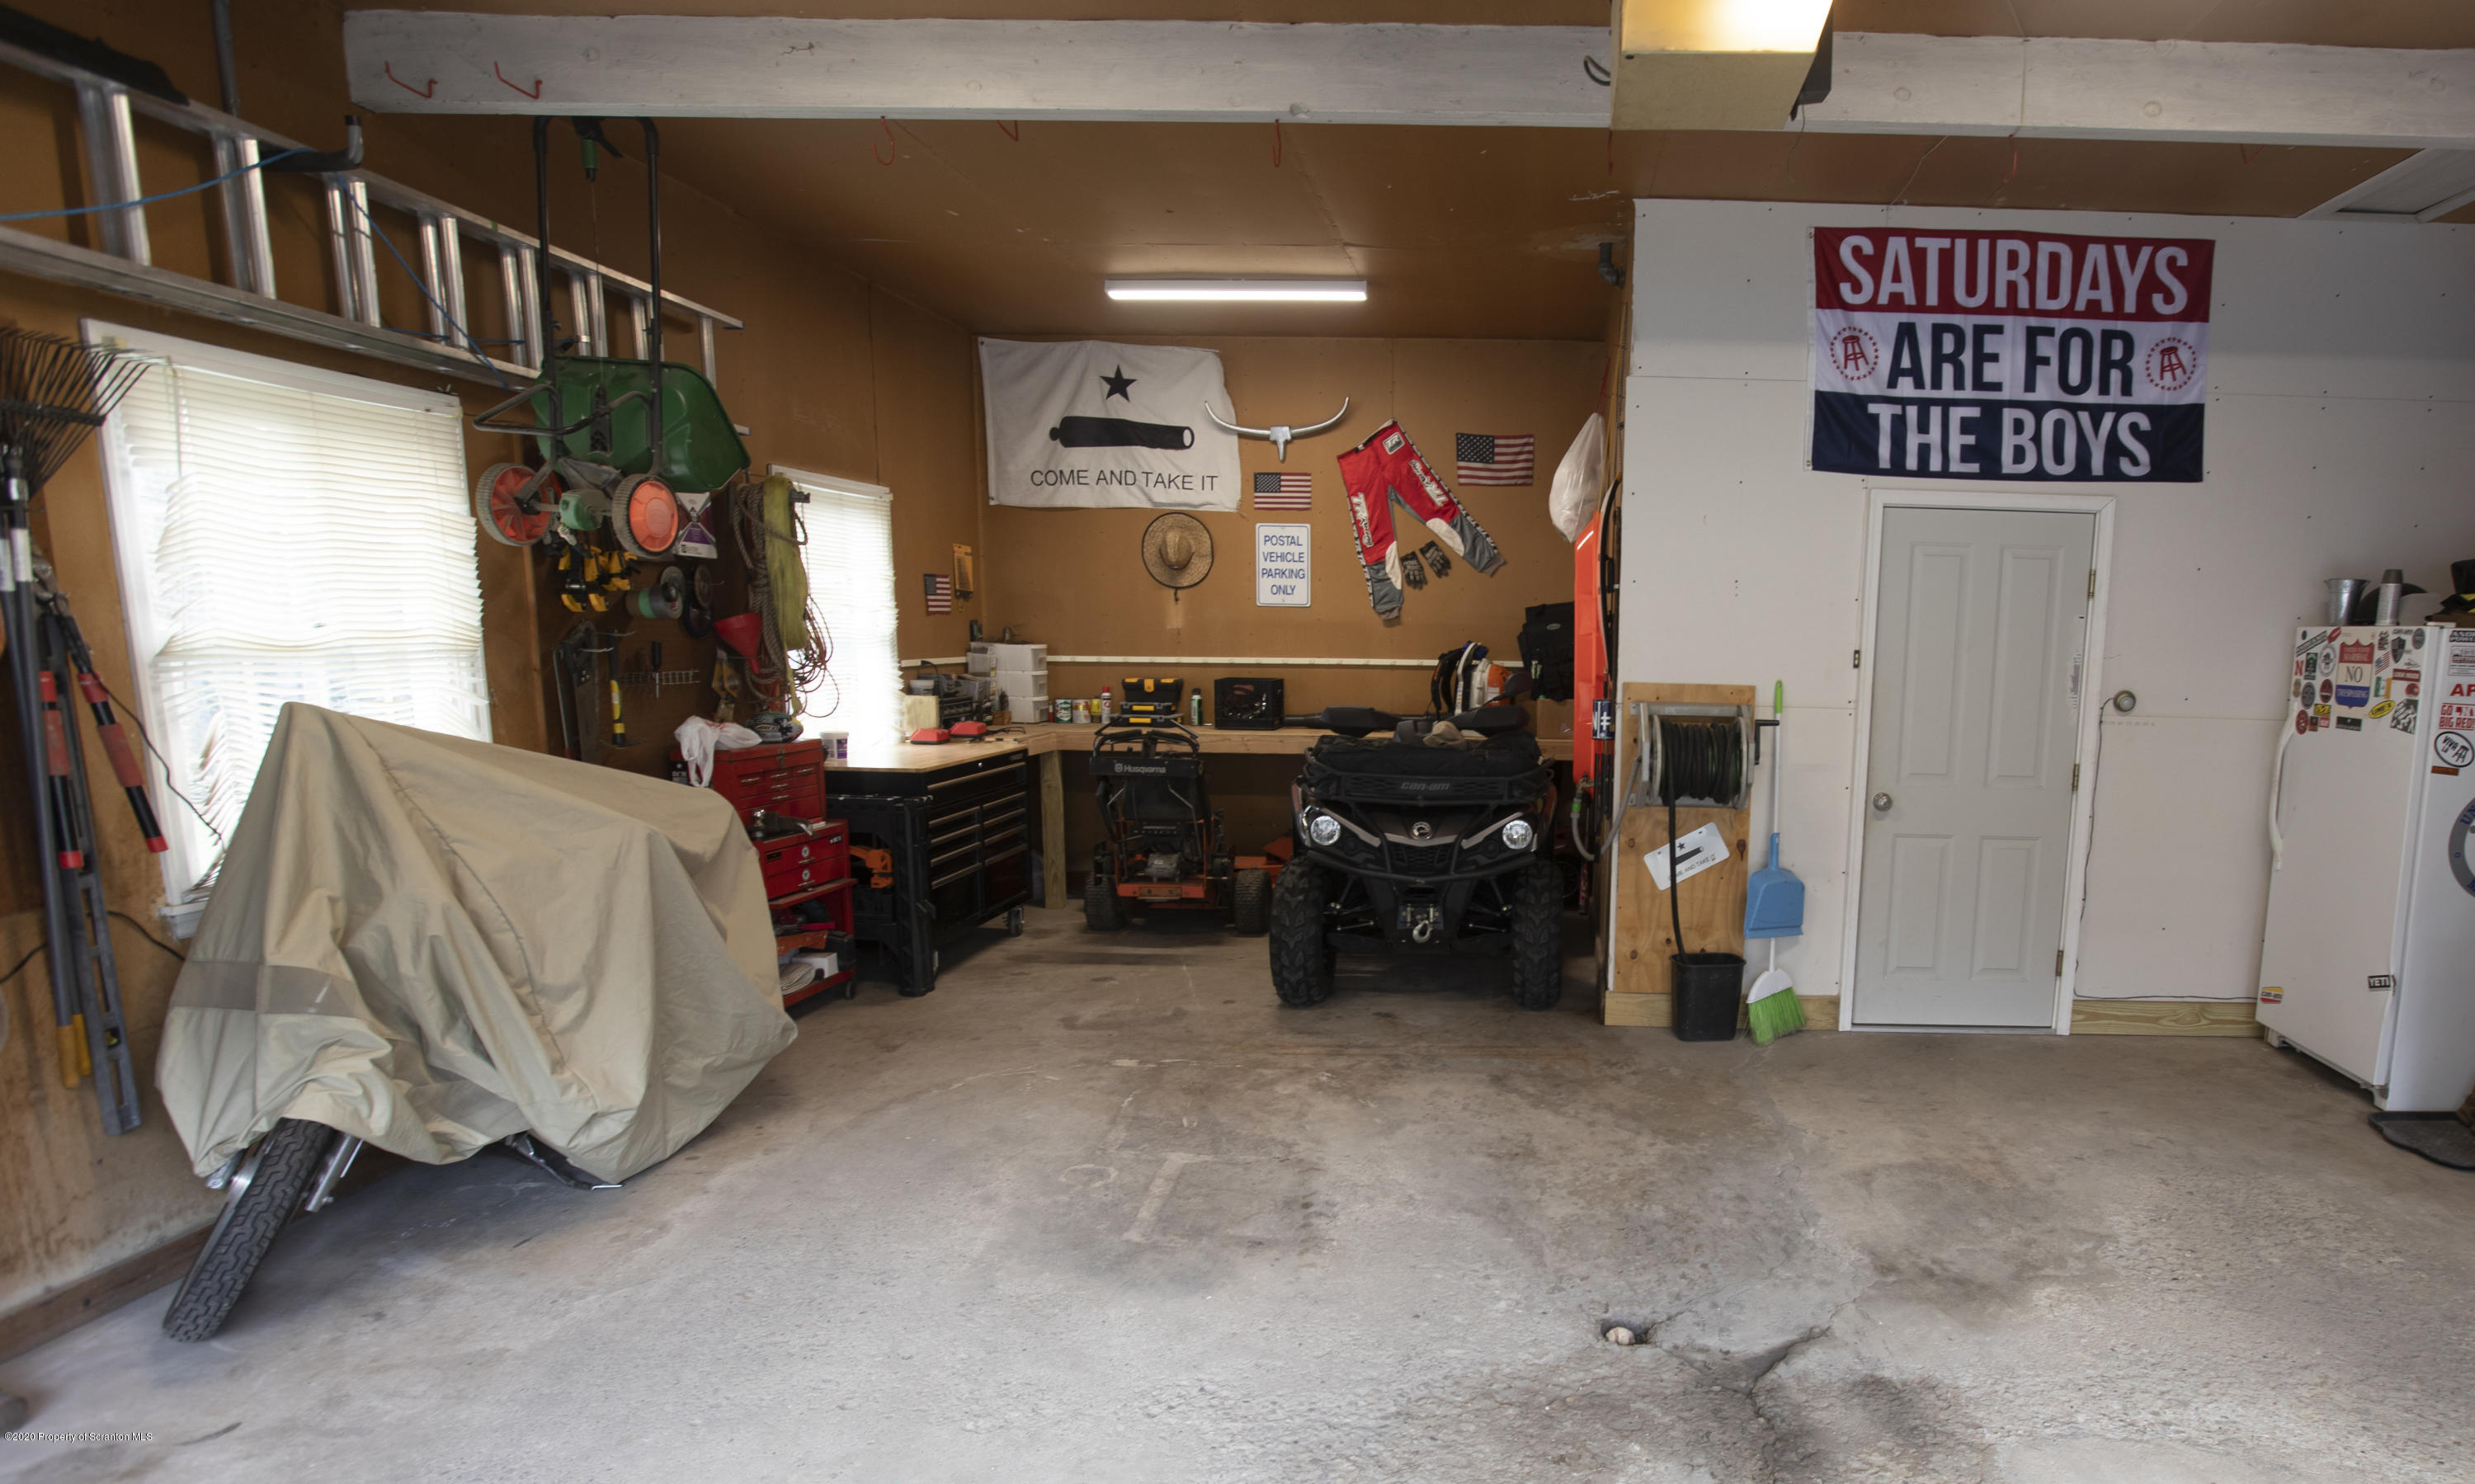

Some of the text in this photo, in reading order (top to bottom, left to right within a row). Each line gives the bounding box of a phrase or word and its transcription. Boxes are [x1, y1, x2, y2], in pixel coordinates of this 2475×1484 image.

[1839, 234, 2189, 315] SATURDAYS
[1887, 322, 2134, 397] ARE FOR
[1868, 403, 2152, 477] THE BOYS
[1030, 469, 1219, 492] COME AND TAKE IT
[1263, 535, 1304, 547] POSTAL
[1262, 551, 1305, 563] VEHICLE
[1261, 568, 1306, 580] PARKING
[1270, 584, 1296, 596] ONLY
[2345, 666, 2364, 683] NO
[2439, 717, 2454, 728] BIG
[1124, 764, 1167, 774] Husqvarna
[1400, 782, 1450, 791] can-am
[2369, 978, 2389, 987] YETI
